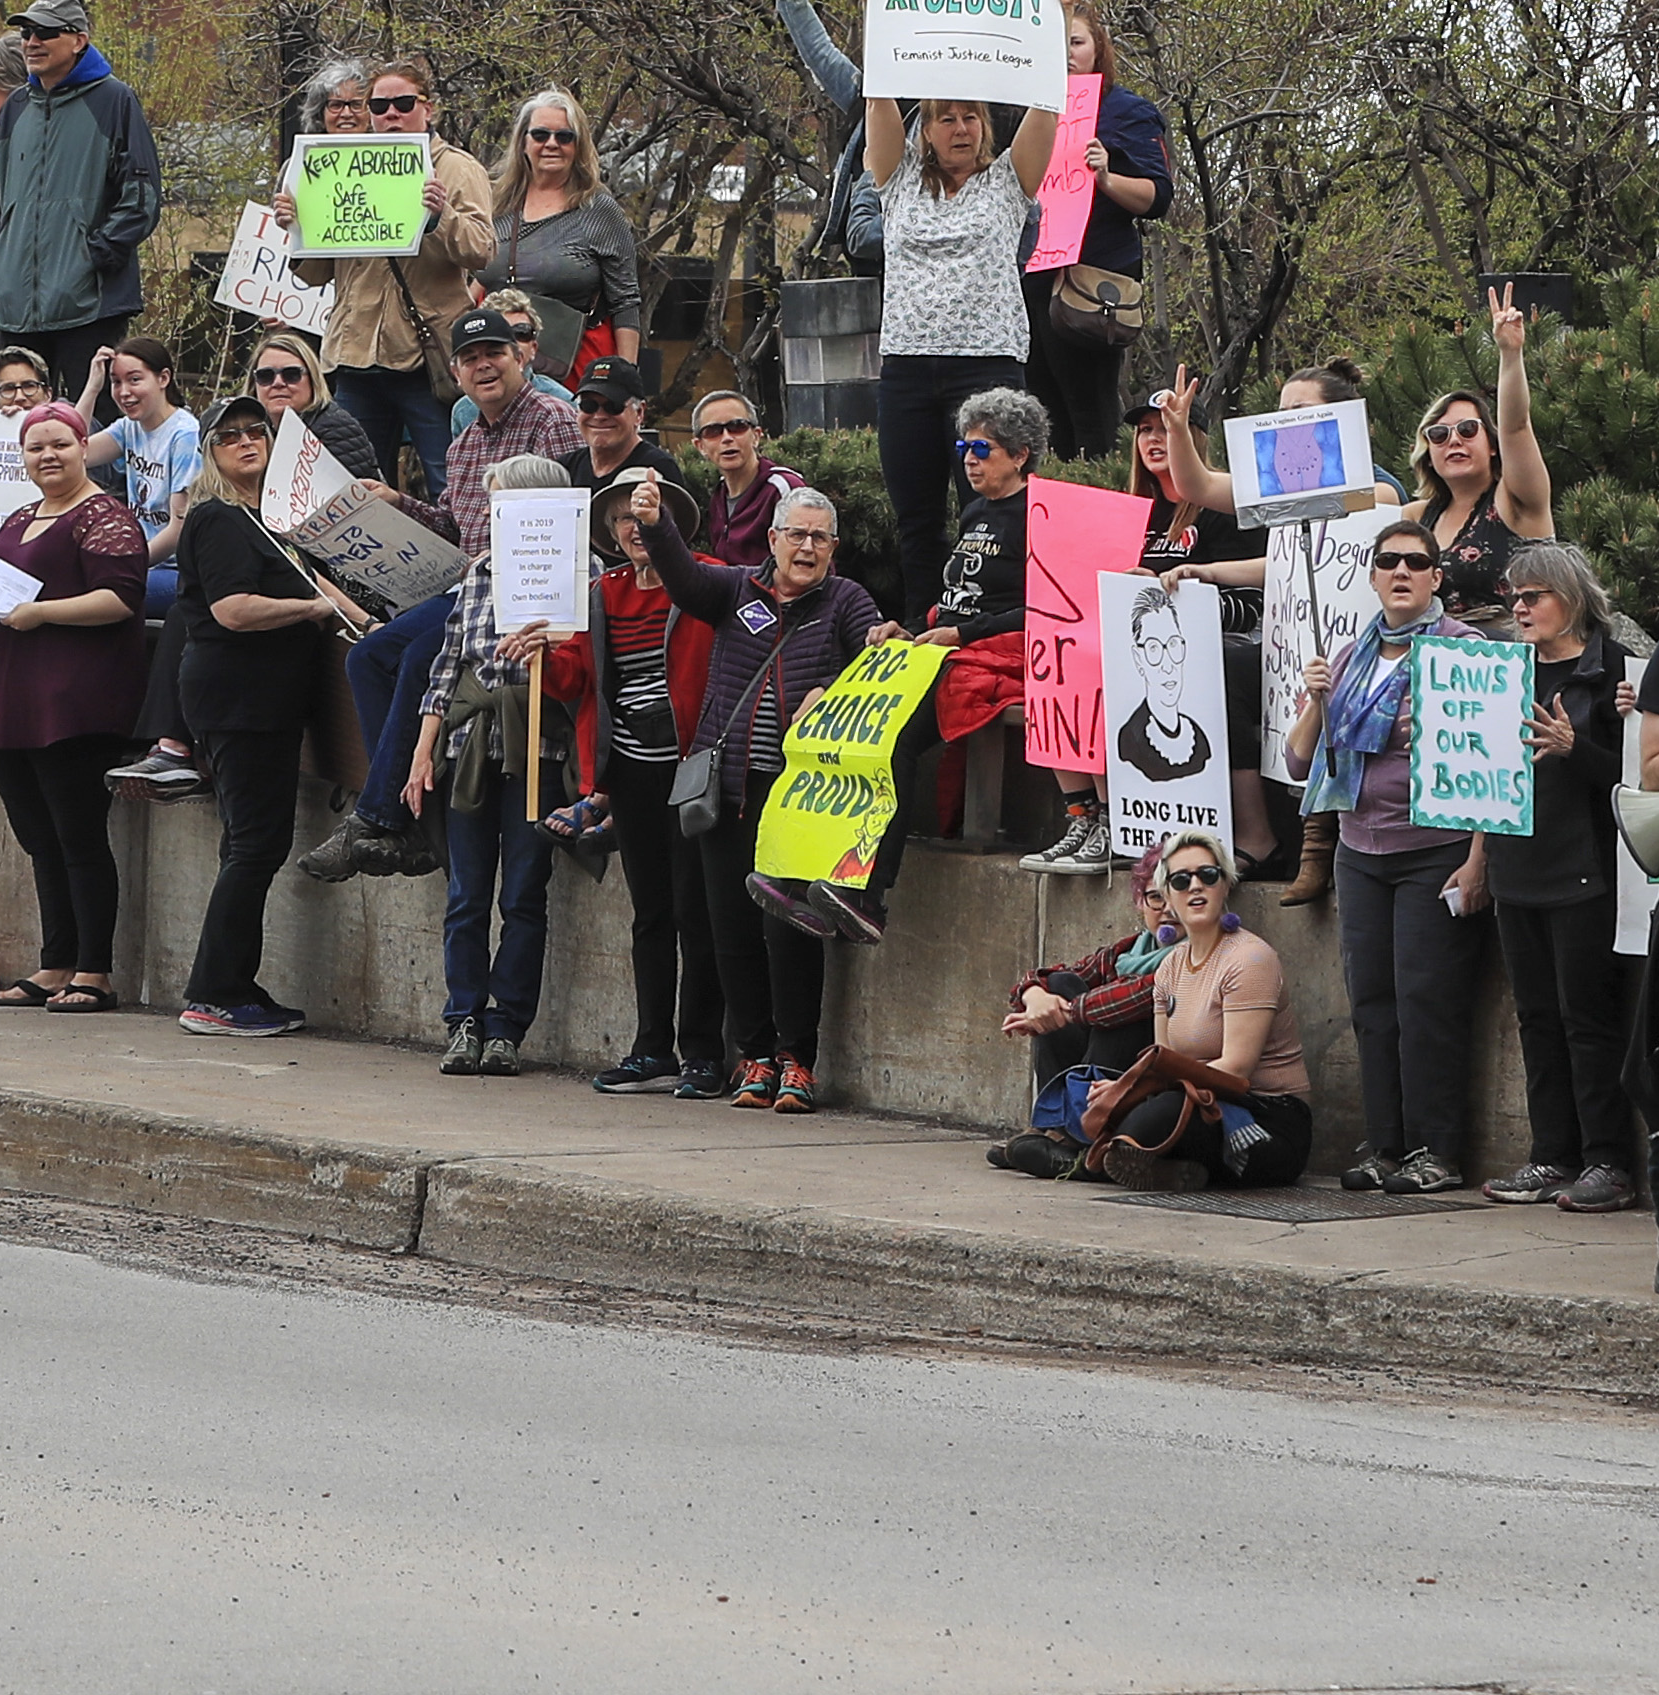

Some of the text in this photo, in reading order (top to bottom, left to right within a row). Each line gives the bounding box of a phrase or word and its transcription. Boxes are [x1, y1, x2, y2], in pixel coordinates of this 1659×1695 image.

[894, 46, 1032, 68] Feminist Justice League
[303, 150, 340, 185] KEEP
[334, 205, 384, 224] LEGAL
[322, 223, 404, 243] ACCESSIBLE
[234, 279, 335, 332] CHOIC
[1316, 411, 1333, 419] Again
[527, 519, 533, 527] is
[535, 519, 554, 527] 2019
[334, 525, 363, 544] TO
[520, 534, 552, 542] Time for
[397, 541, 420, 565] IN
[519, 563, 553, 573] In charge
[521, 578, 530, 586] Of
[512, 592, 560, 602] Own bodies!!
[1321, 603, 1359, 660] you
[846, 647, 908, 683] PRO-
[1431, 656, 1508, 694] LAWS
[797, 693, 904, 745] CHOICE
[1442, 699, 1484, 722] OFF
[1436, 729, 1490, 759] OUR
[818, 745, 843, 766] and
[780, 770, 874, 818] PROUD
[1431, 762, 1525, 806] BODIES
[1121, 797, 1218, 827] LONG LIVE
[1120, 827, 1155, 846] THE
